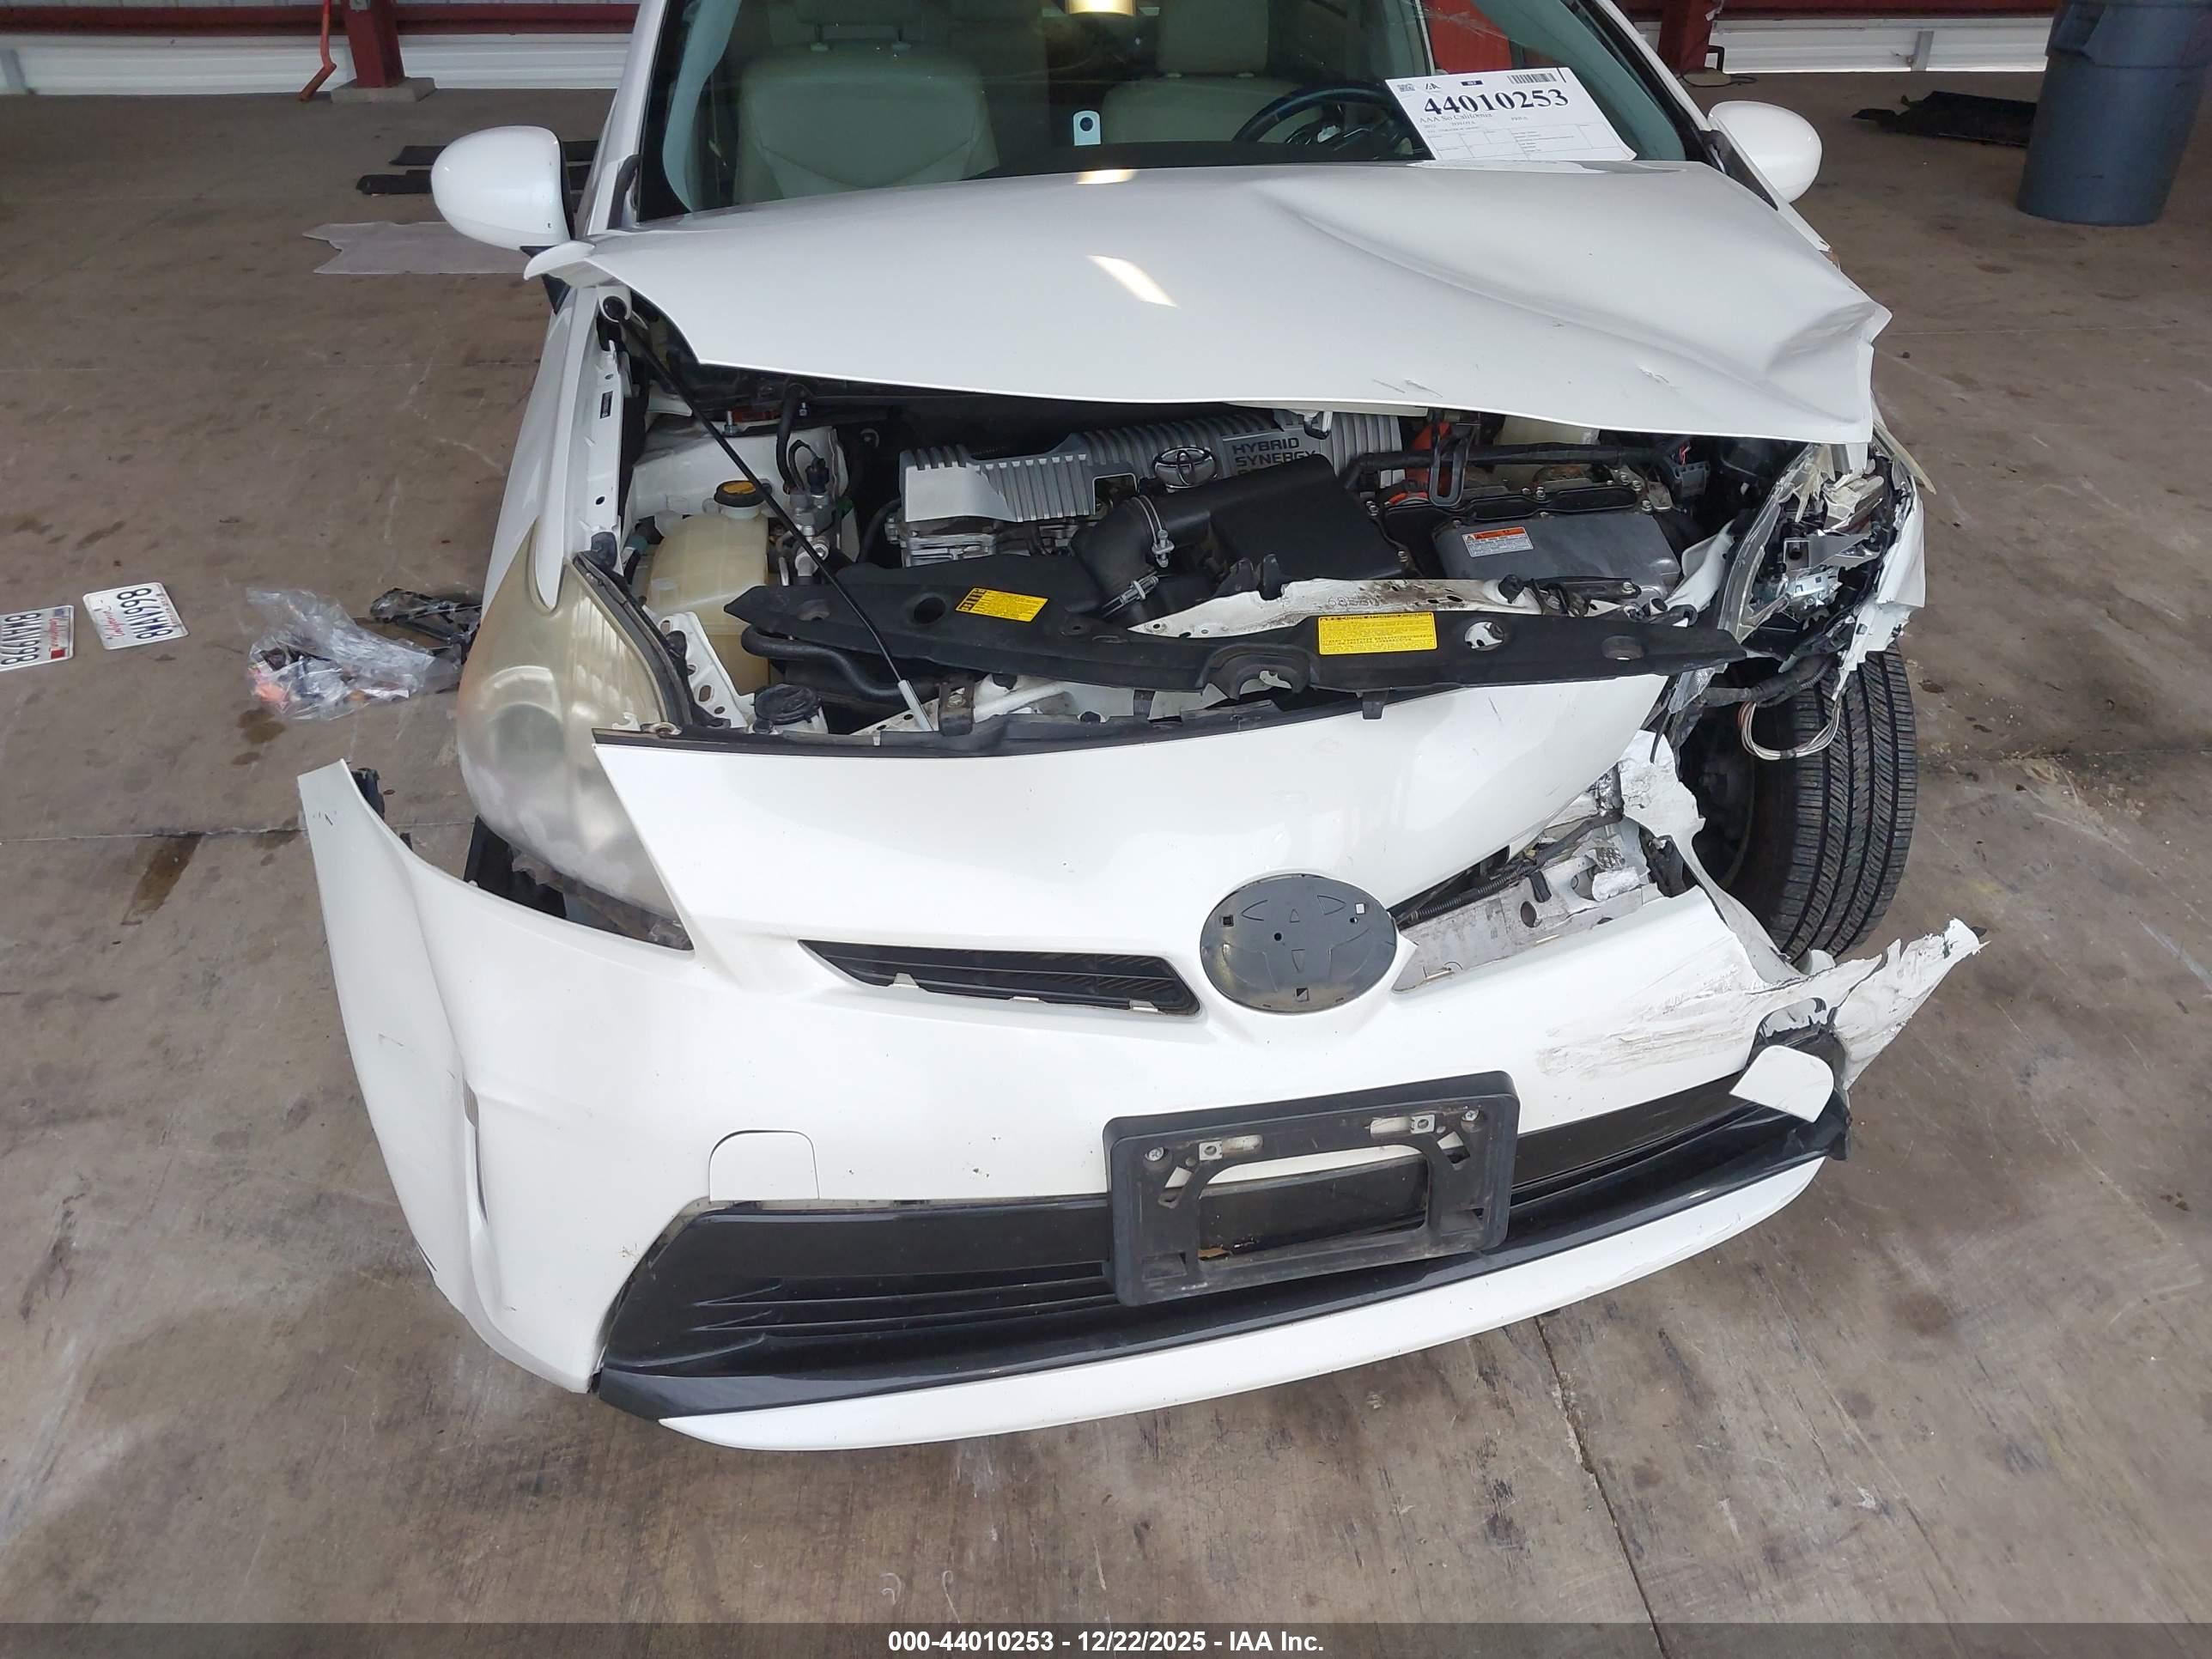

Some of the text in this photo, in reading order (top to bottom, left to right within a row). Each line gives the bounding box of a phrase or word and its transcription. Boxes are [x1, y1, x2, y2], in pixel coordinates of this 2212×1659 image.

[1425, 88, 1569, 115] 44010253
[1454, 112, 1492, 121] California
[1233, 438, 1299, 454] HYBRID
[1235, 450, 1316, 466] SYNERGY
[103, 609, 126, 638] California
[117, 587, 173, 640] 8MAV998
[1, 612, 42, 665] 8MAV998
